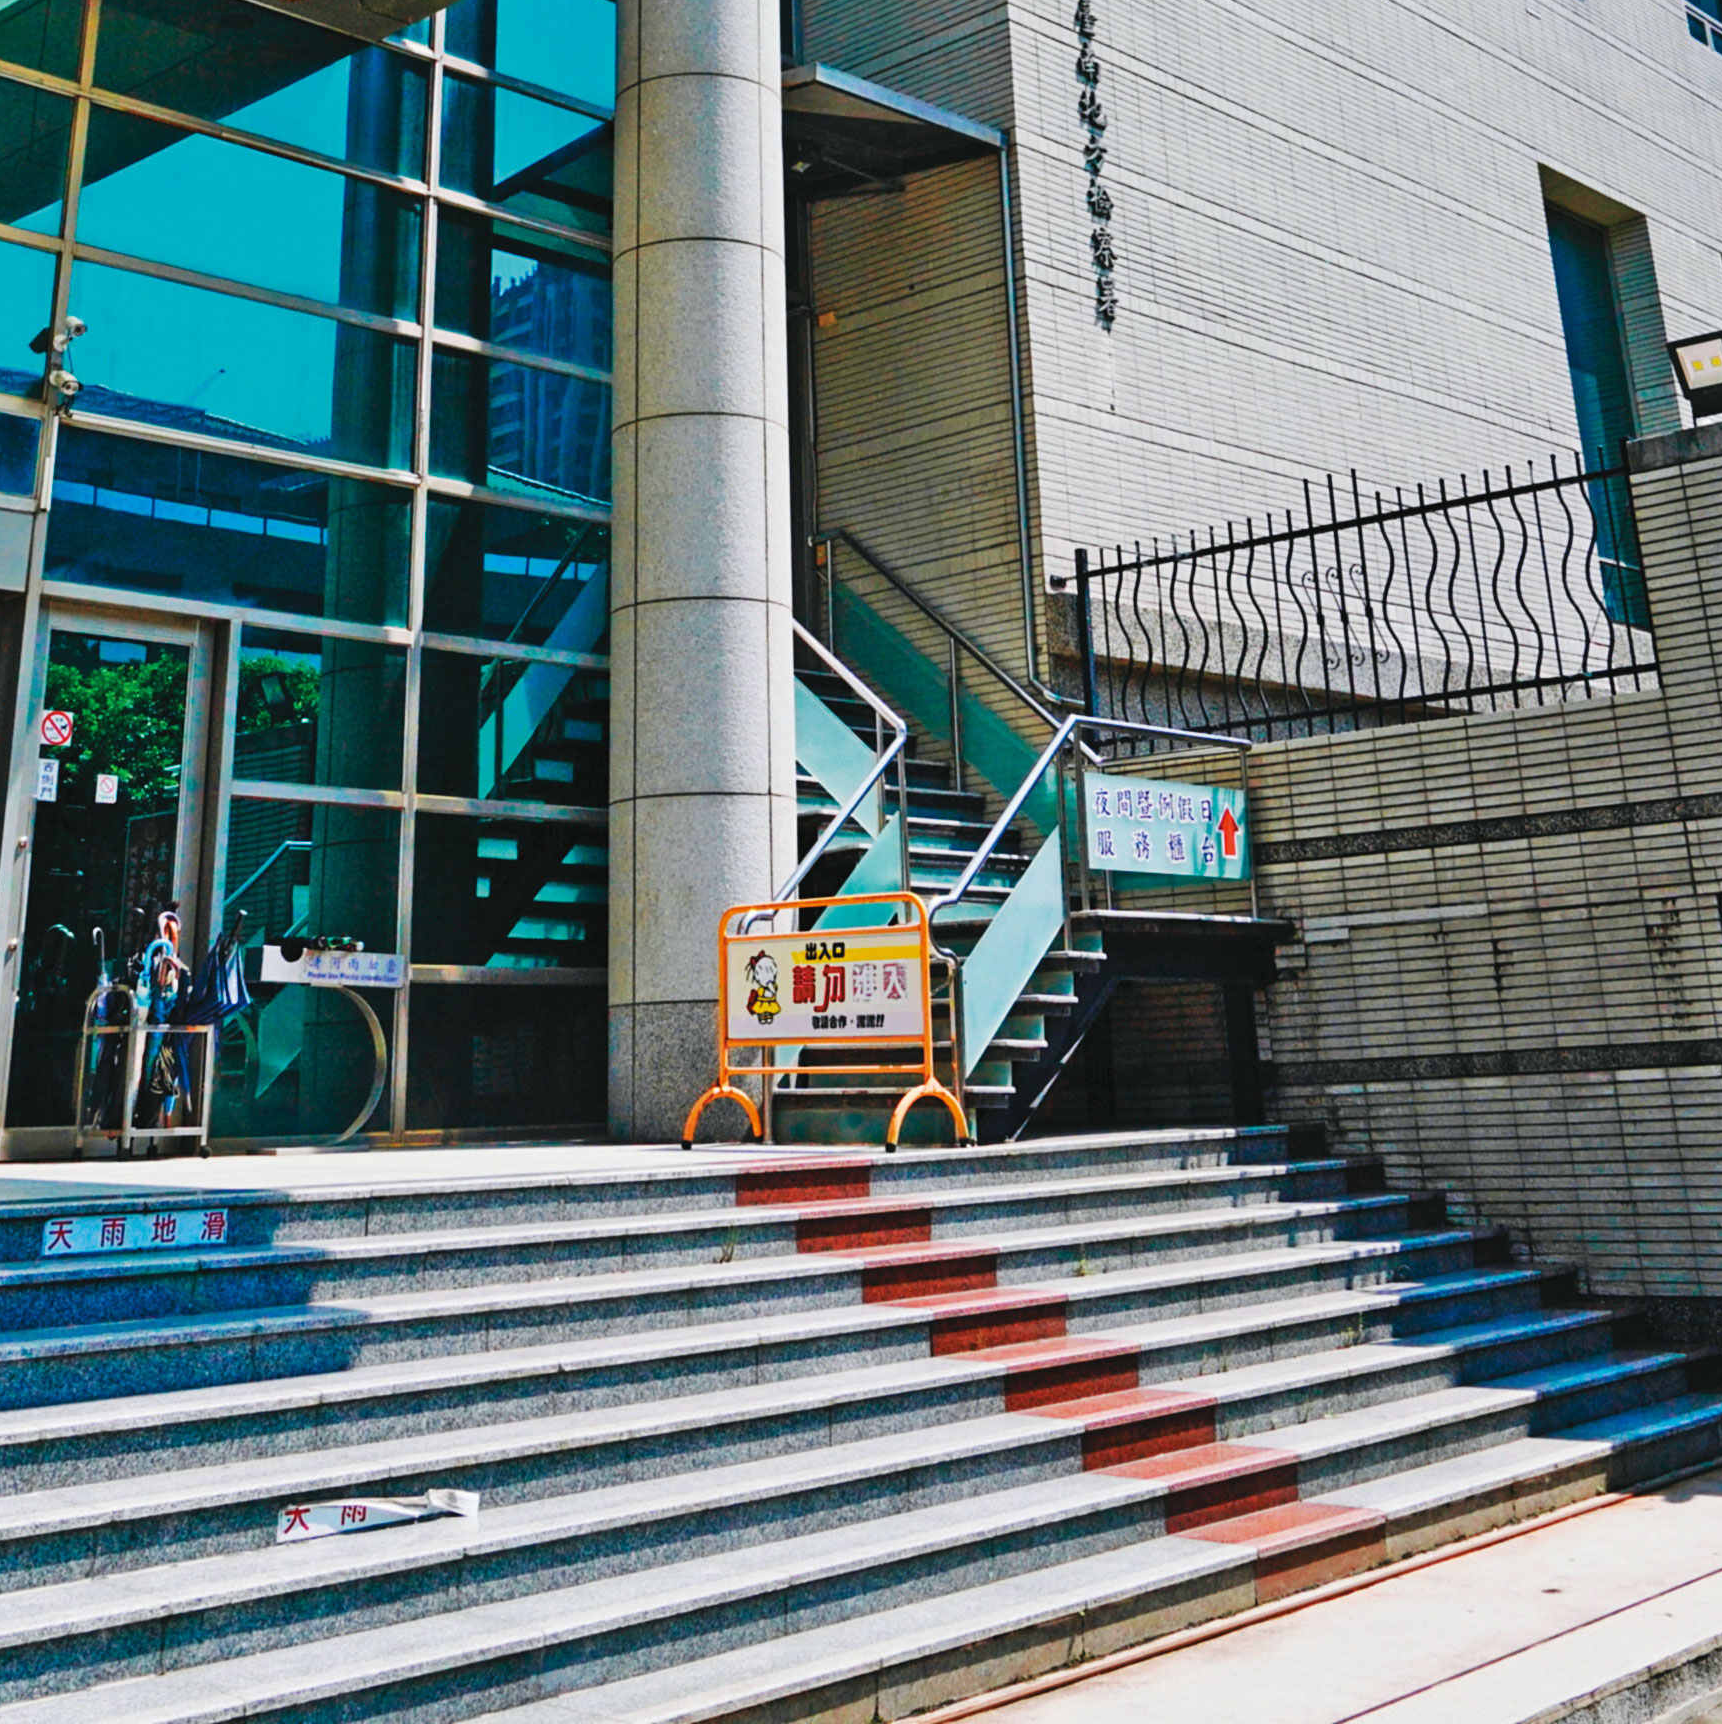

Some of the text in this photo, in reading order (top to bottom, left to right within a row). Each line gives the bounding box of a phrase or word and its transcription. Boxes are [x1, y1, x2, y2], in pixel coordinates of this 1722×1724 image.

[1095, 788, 1213, 822] 夜間暨例假日
[1097, 830, 1215, 863] 服務櫃台
[805, 942, 845, 960] 出入口
[47, 1211, 226, 1251] 天雨地滑
